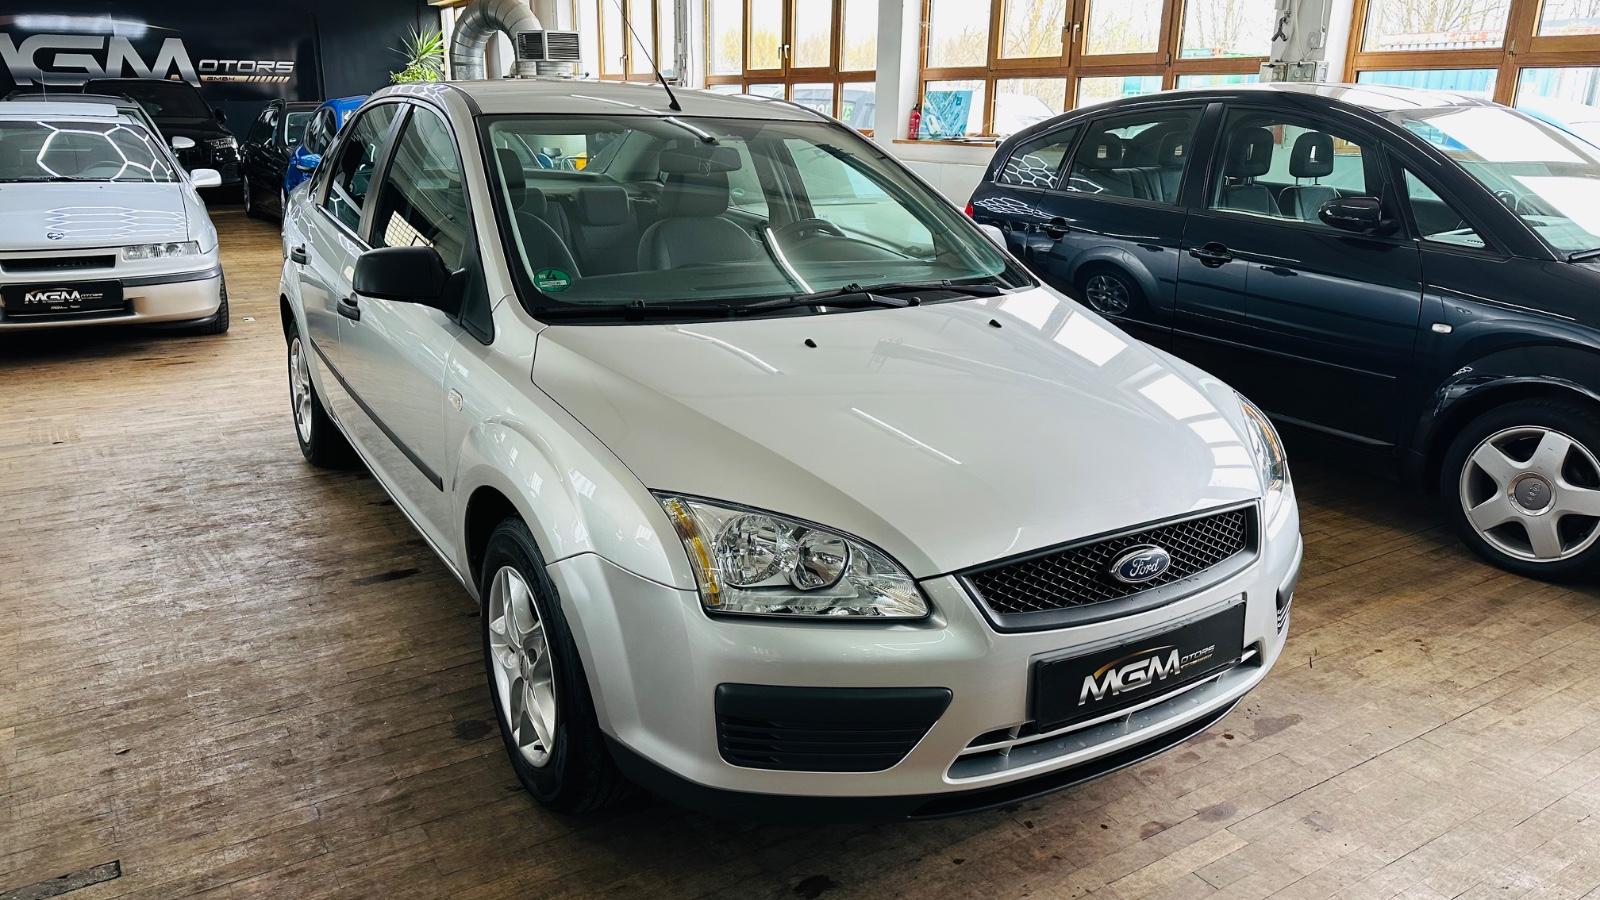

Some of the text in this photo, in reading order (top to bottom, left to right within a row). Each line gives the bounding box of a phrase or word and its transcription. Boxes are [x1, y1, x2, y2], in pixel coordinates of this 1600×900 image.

[198, 59, 295, 73] OTORS
[1129, 556, 1160, 577] Ford
[1078, 648, 1181, 706] MGM
